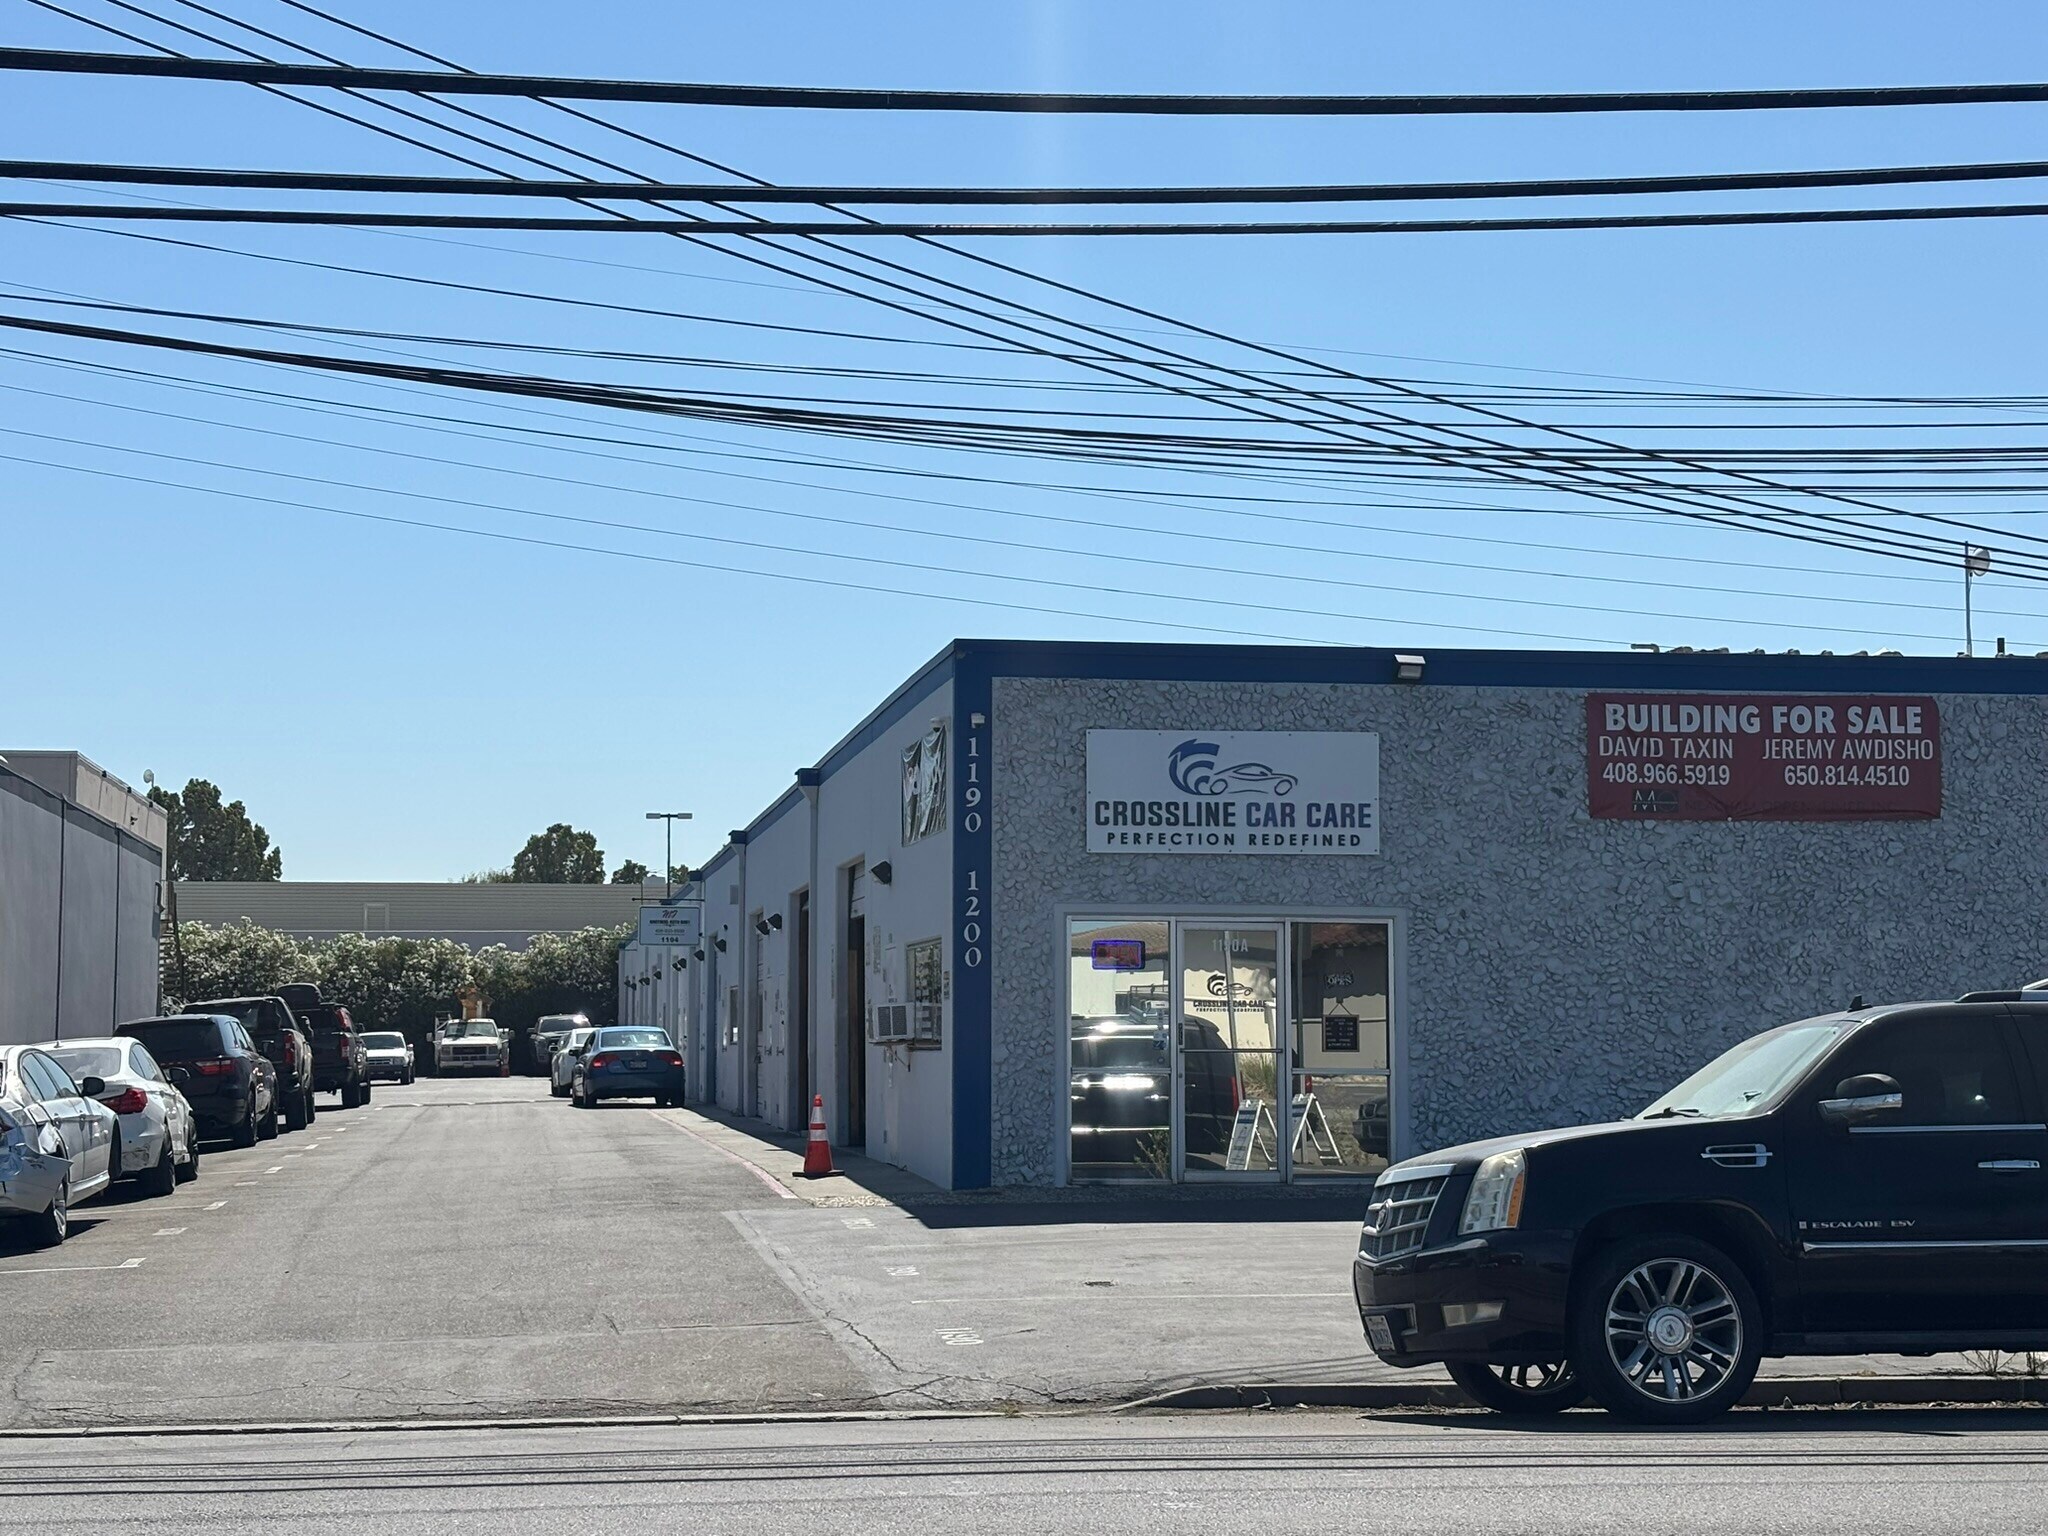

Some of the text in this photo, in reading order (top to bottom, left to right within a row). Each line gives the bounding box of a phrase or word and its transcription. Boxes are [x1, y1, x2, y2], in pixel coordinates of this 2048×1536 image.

[1605, 703, 1922, 734] BUILDING FOR SALE
[1599, 736, 1733, 759] DAVID TAXIN
[1762, 738, 1934, 760] JEREMY AWDISHO
[1602, 762, 1730, 786] 408.966.5919
[1784, 765, 1910, 786] 650.814.4510
[1095, 800, 1371, 829] CROSSLINE CAR CARE
[1107, 832, 1361, 847] PERFECTION REDEFINED
[963, 736, 982, 968] 1190 1200
[1812, 1220, 1882, 1229] ESCALADE
